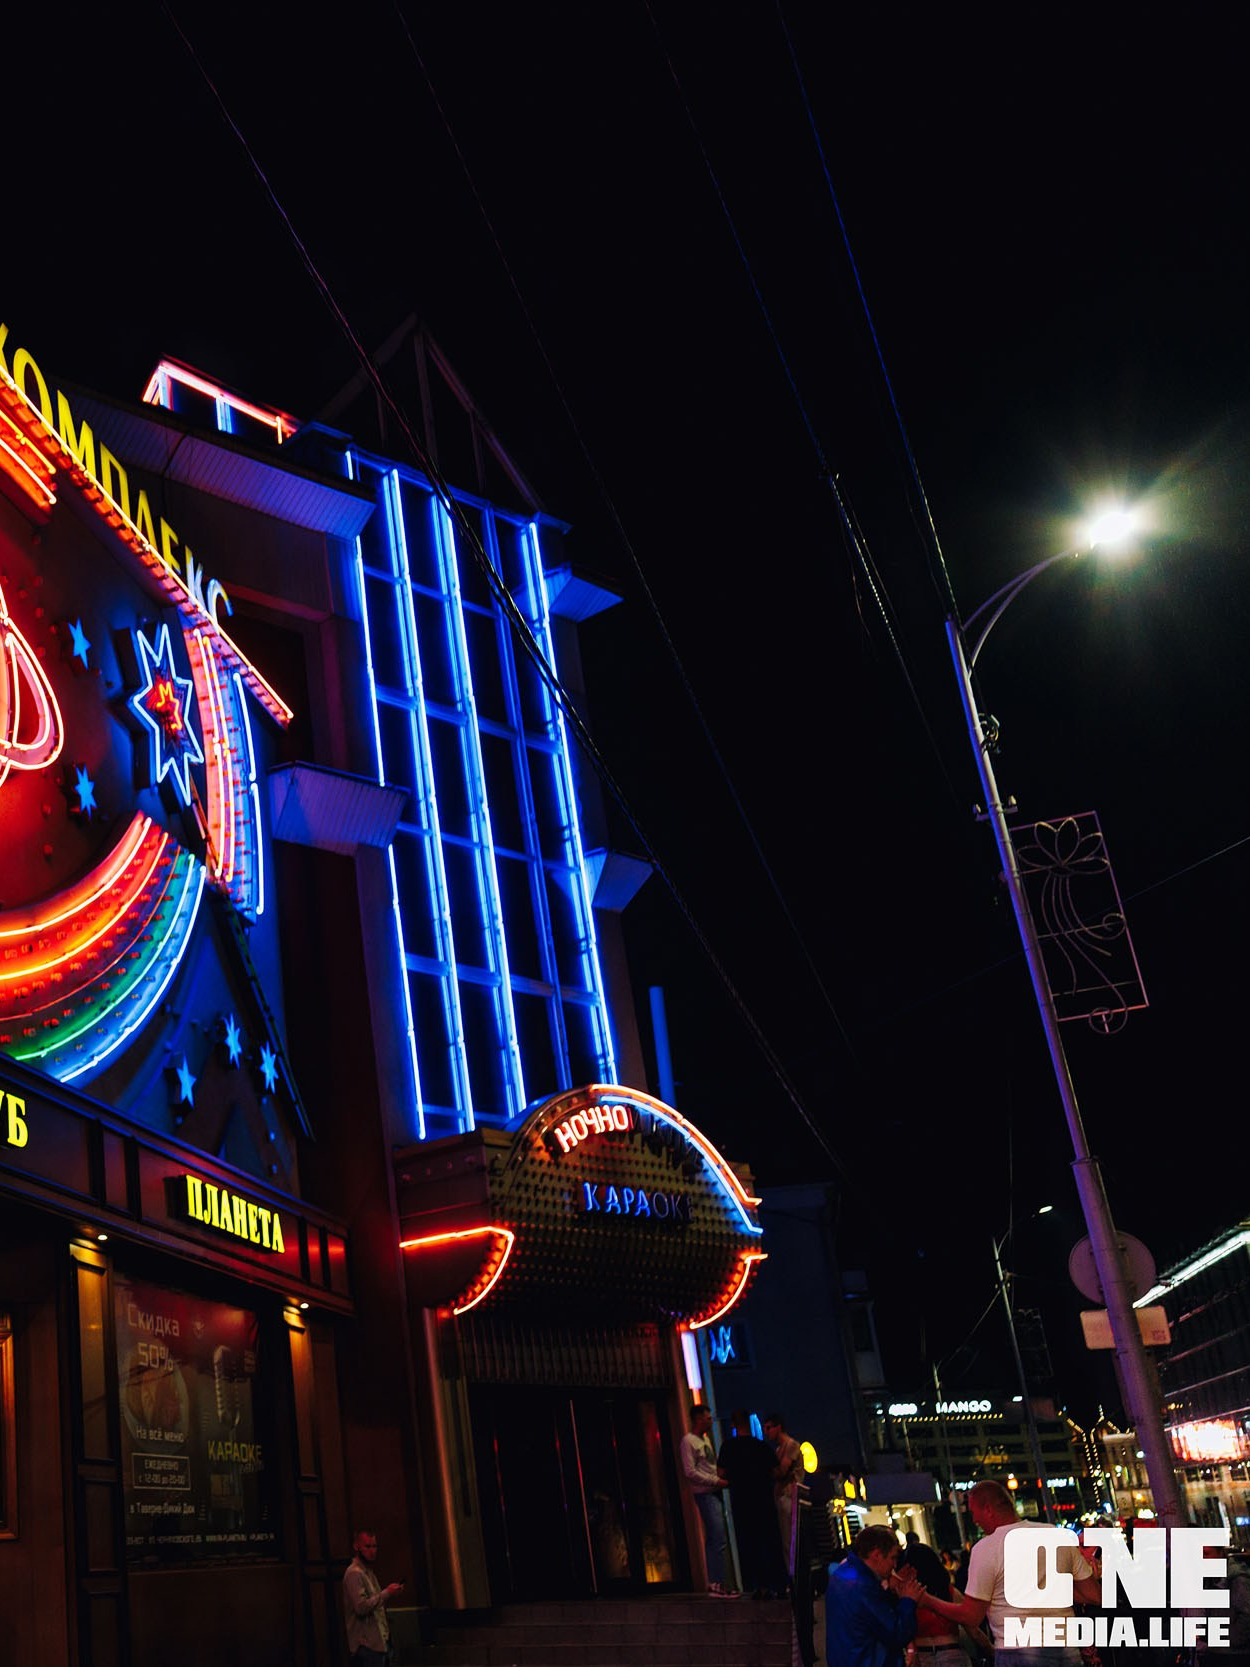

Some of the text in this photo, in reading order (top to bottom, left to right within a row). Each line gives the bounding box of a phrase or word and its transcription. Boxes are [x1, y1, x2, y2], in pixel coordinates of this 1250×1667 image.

[186, 1174, 285, 1253] ПЛАНЕТА
[127, 1304, 180, 1337] Скидка
[137, 1342, 174, 1372] 50%
[207, 1440, 262, 1464] КАРАОКЕ
